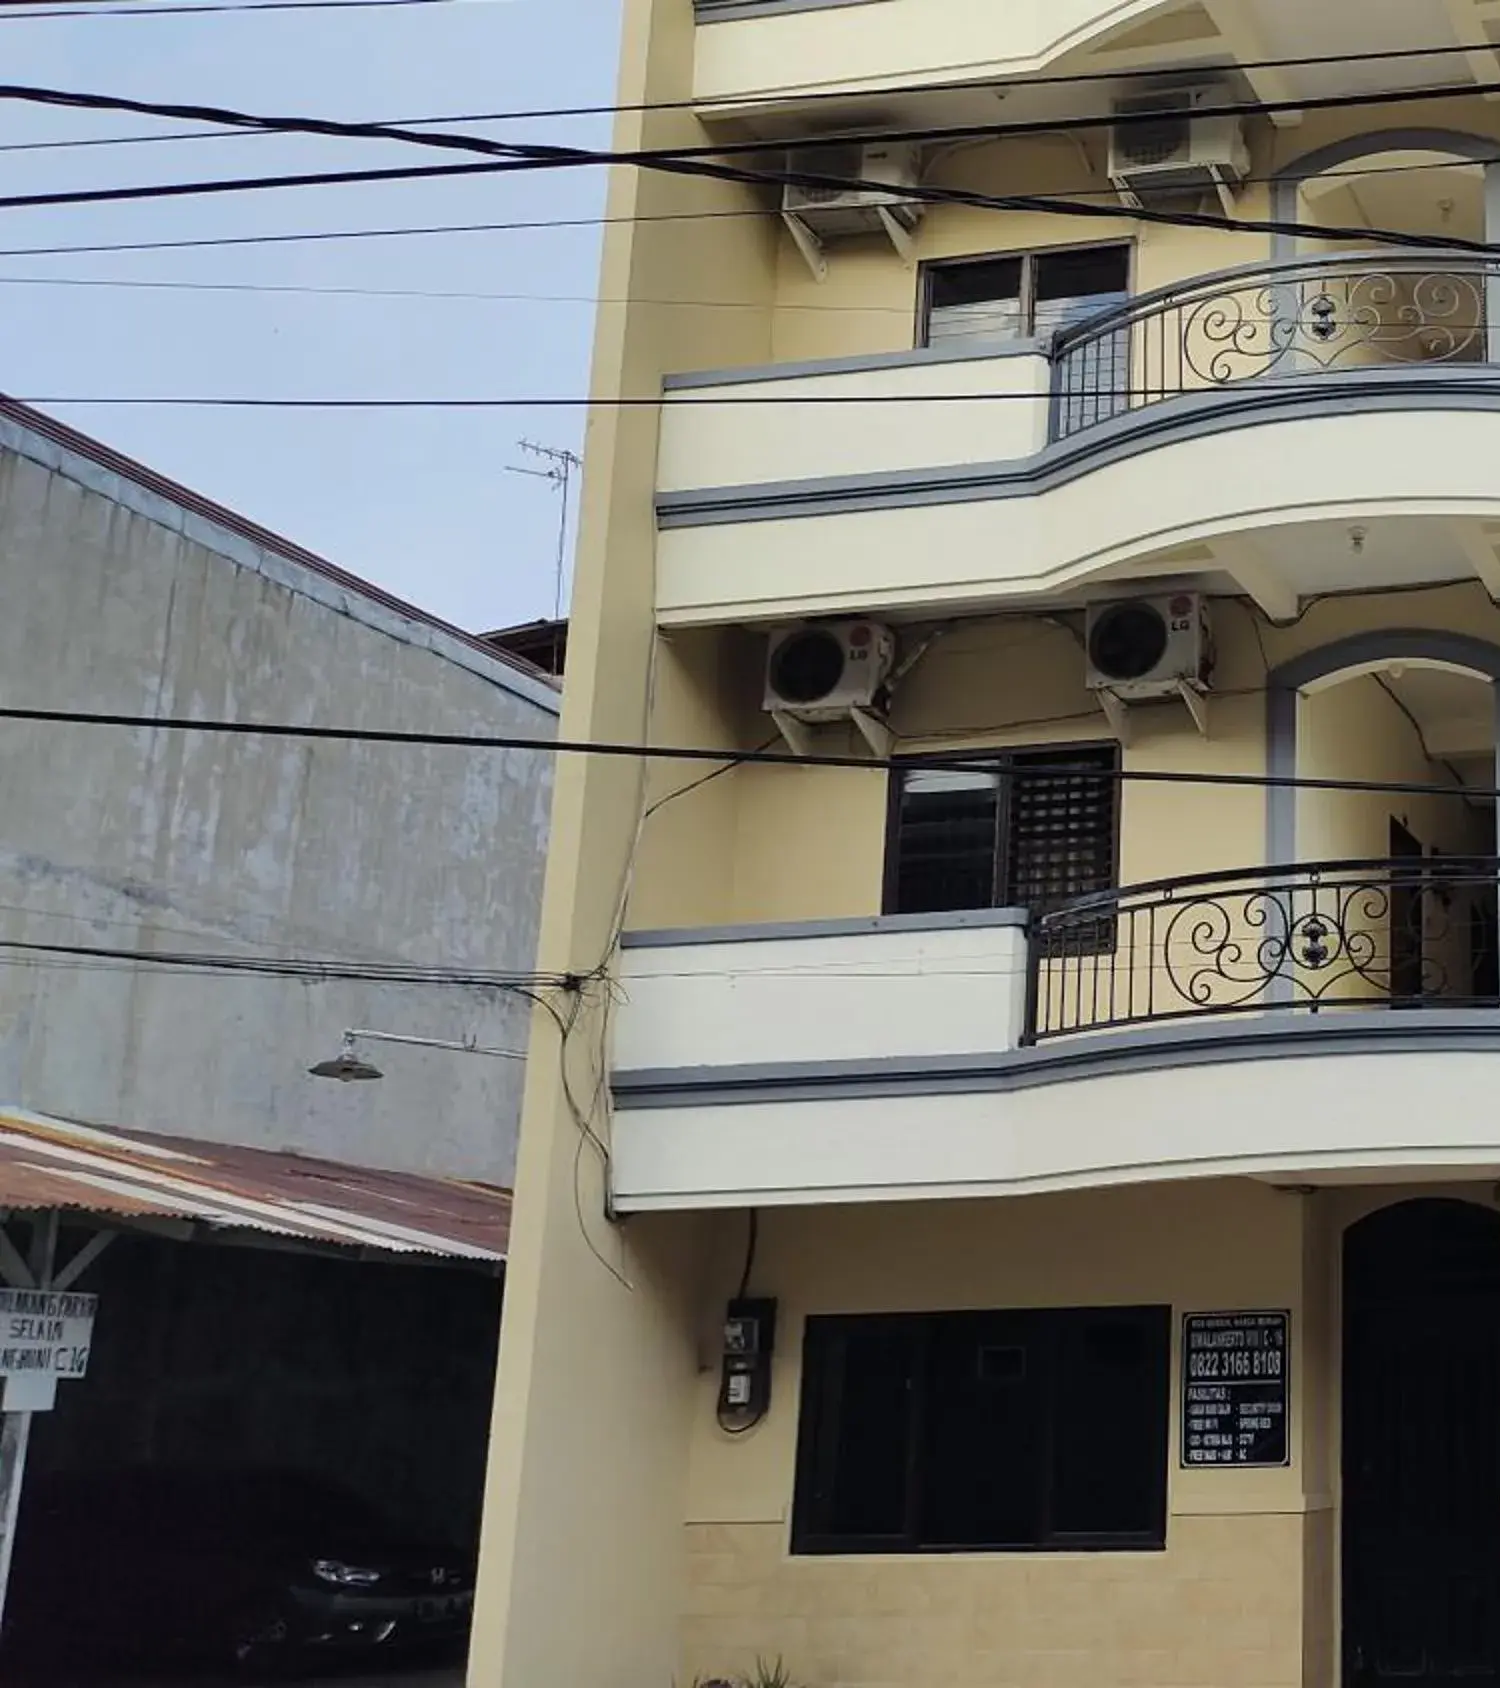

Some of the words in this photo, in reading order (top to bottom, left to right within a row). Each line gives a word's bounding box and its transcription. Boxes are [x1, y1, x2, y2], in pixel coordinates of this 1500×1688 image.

[1171, 620, 1189, 632] LG
[849, 649, 868, 661] LG
[1190, 1351, 1219, 1377] 0822
